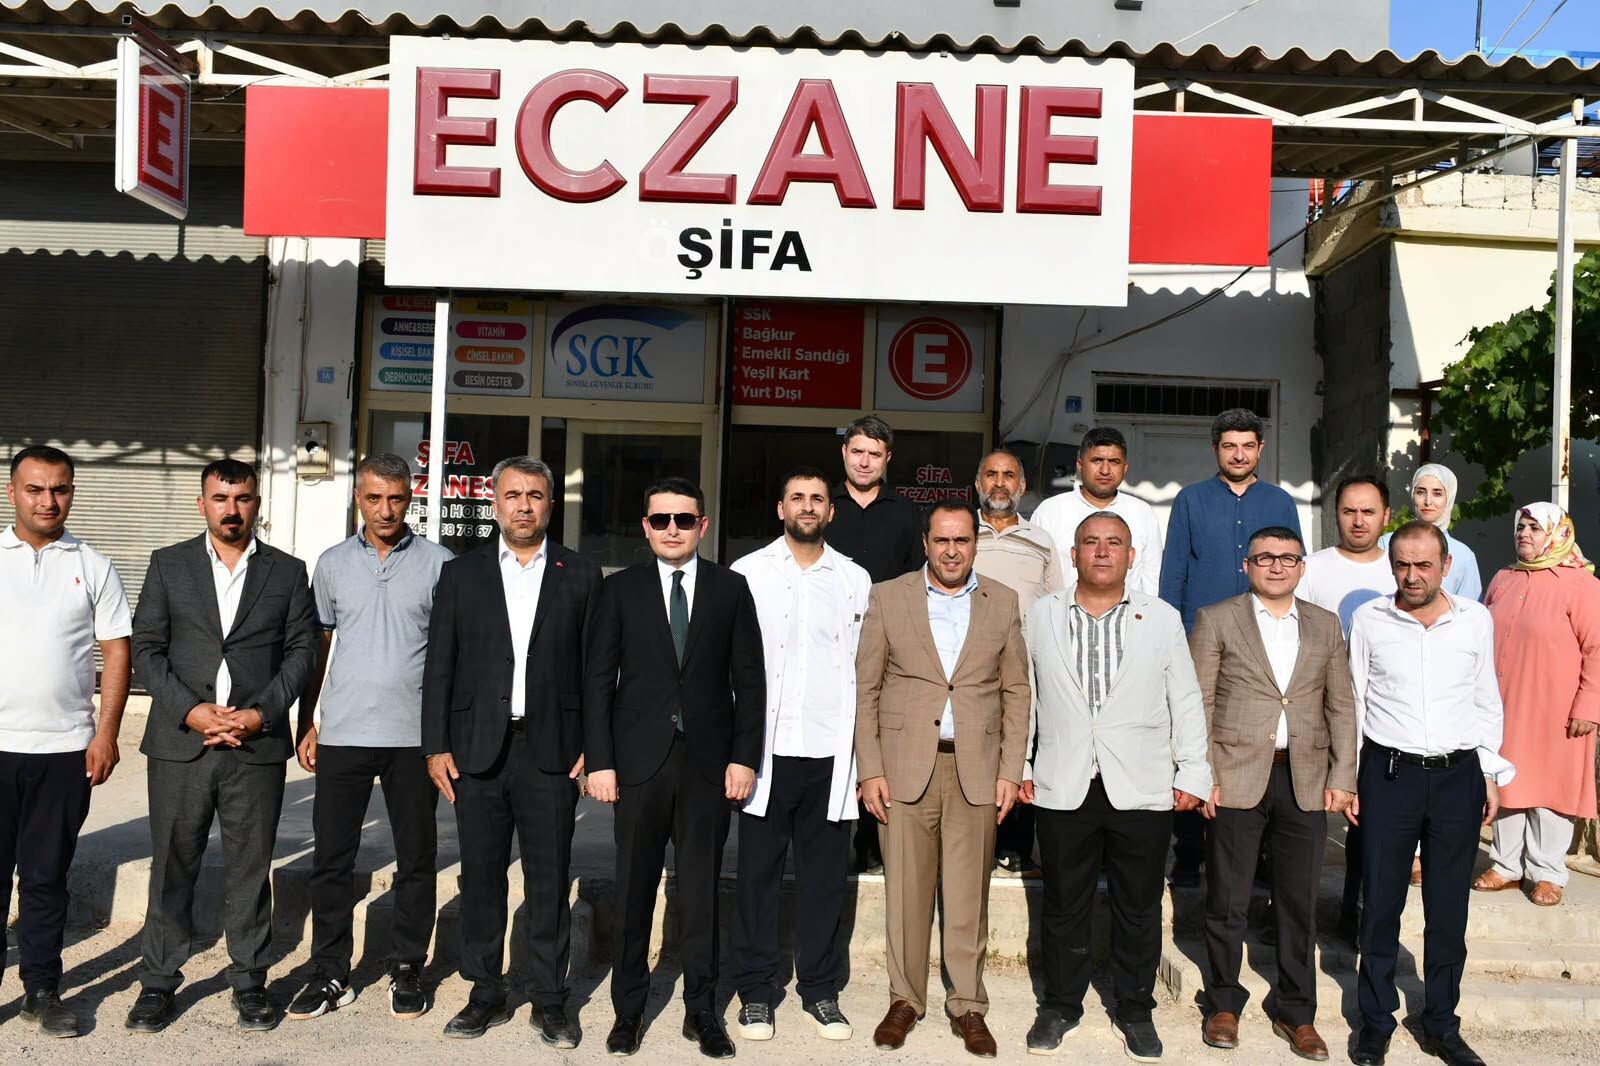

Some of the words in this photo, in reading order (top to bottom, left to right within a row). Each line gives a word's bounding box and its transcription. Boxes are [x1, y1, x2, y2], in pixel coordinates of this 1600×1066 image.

[413, 66, 1103, 216] ECZANE
[677, 218, 812, 280] ŞİFA
[743, 307, 772, 321] SSK
[743, 327, 796, 342] Bağkur
[566, 334, 654, 379] SGK
[741, 345, 791, 361] Emekli
[795, 348, 850, 365] Sandığı
[912, 333, 949, 385] E
[741, 364, 775, 381] Yeşil
[778, 367, 810, 381] Kart
[741, 384, 771, 399] Yurt
[775, 385, 802, 402] Dışı
[415, 440, 475, 468] ŞFA
[916, 464, 952, 485] ŞİFA
[456, 524, 473, 536] 76
[475, 524, 493, 538] 67
